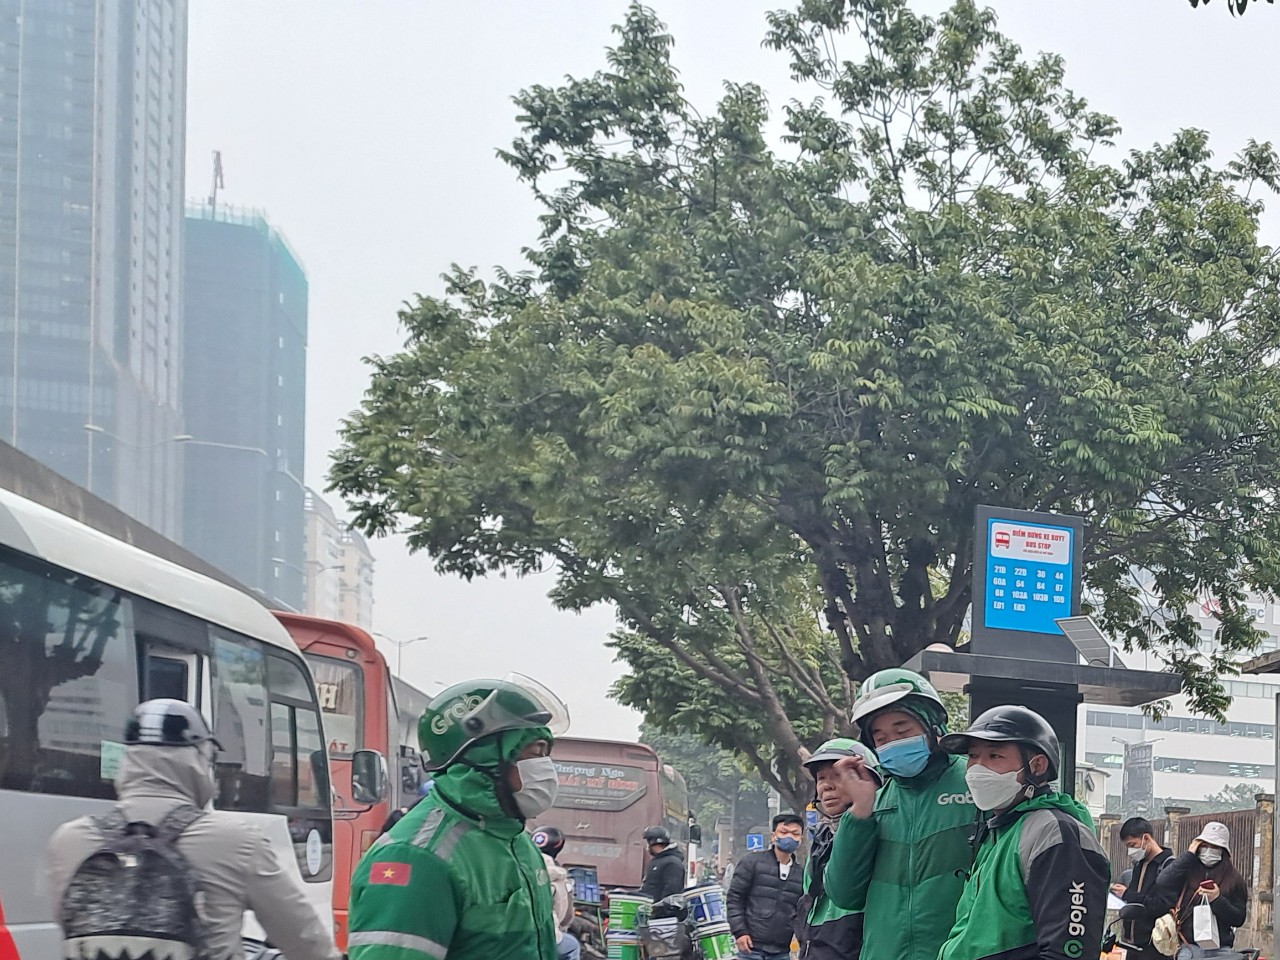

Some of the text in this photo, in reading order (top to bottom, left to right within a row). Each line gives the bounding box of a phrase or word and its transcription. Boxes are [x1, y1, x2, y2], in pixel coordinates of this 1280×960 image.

[1038, 542, 1051, 550] STOP
[937, 791, 976, 805] Grab
[1069, 880, 1085, 936] gojek
